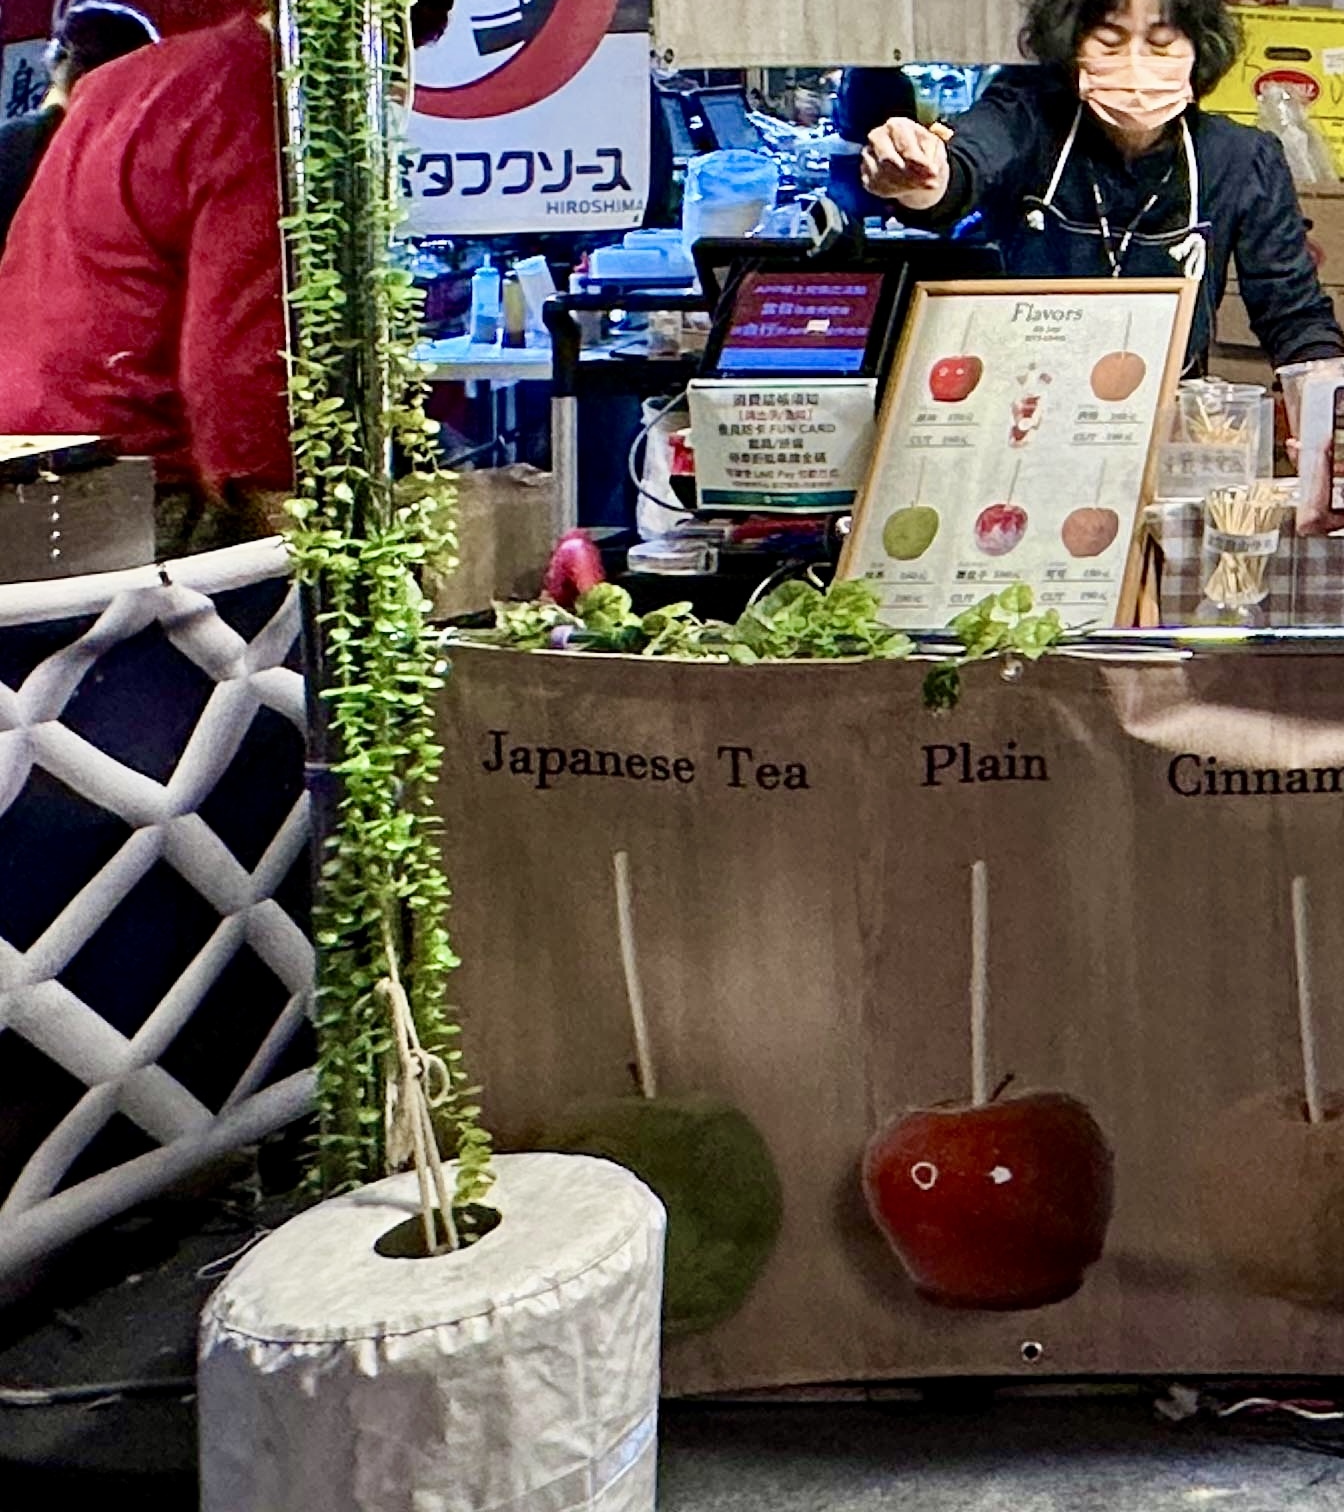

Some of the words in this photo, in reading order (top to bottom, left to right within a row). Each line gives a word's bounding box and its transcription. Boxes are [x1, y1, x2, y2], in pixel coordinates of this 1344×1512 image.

[1011, 302, 1083, 322] Flavors
[484, 730, 695, 789] Japanese
[718, 746, 809, 790] Tea
[922, 741, 1048, 786] Plain
